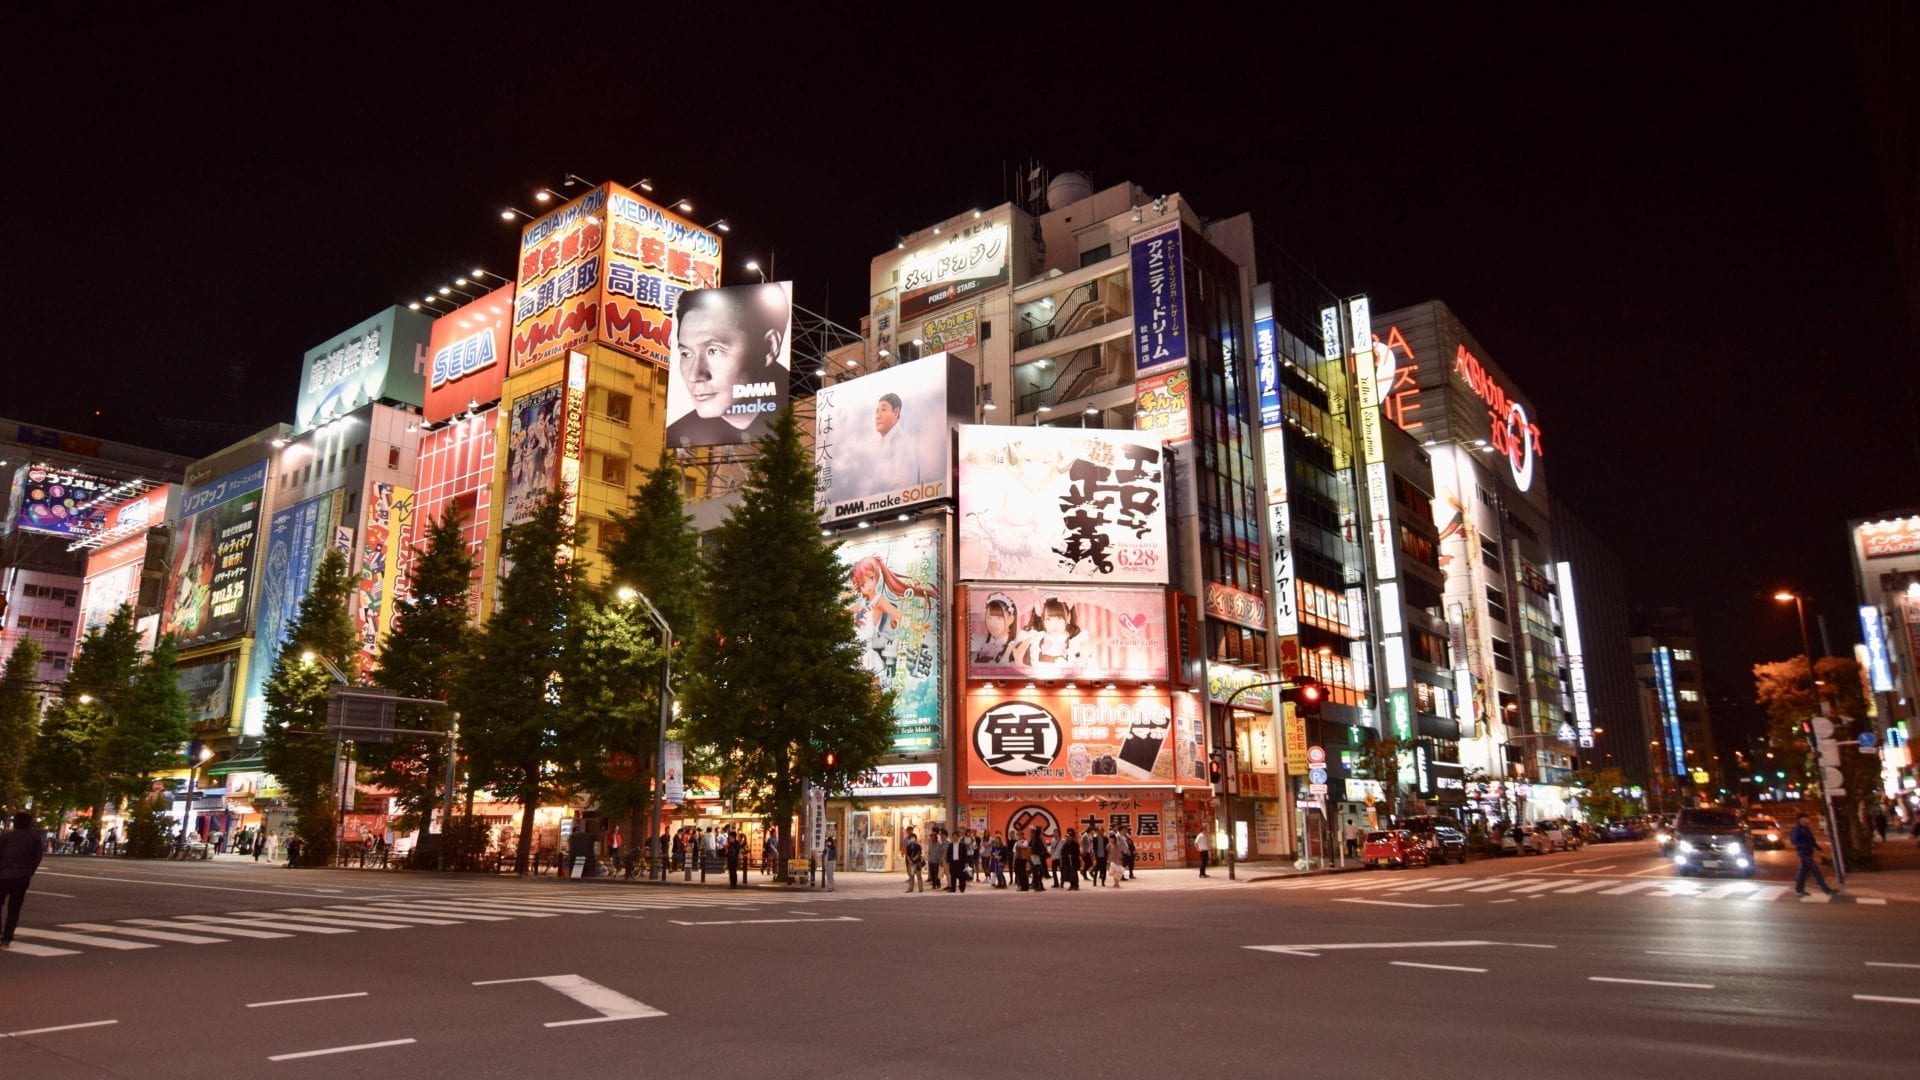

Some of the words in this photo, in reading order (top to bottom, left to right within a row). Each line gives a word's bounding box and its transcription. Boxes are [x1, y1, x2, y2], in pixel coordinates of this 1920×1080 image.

[516, 257, 598, 323] 高額買取
[608, 262, 688, 312] 高額買
[928, 291, 947, 304] POKER
[956, 280, 977, 294] STARS
[1147, 238, 1170, 360] アメニティードリーム
[432, 328, 497, 387] SEGA
[519, 351, 544, 368] ムーラン
[543, 346, 563, 358] AKIBA
[615, 337, 649, 355] ムーラン
[732, 382, 777, 397] DMM
[1140, 390, 1186, 413] まんが
[1361, 376, 1370, 404] Yellow
[1363, 411, 1377, 457] Submarine
[184, 481, 228, 513] ソフマップ
[902, 480, 944, 503] solar
[915, 725, 932, 734] Model
[984, 711, 1053, 767] 質
[891, 773, 911, 787] ZIN
[1098, 800, 1142, 809] チケット
[1080, 813, 1162, 837] 大黒屋
